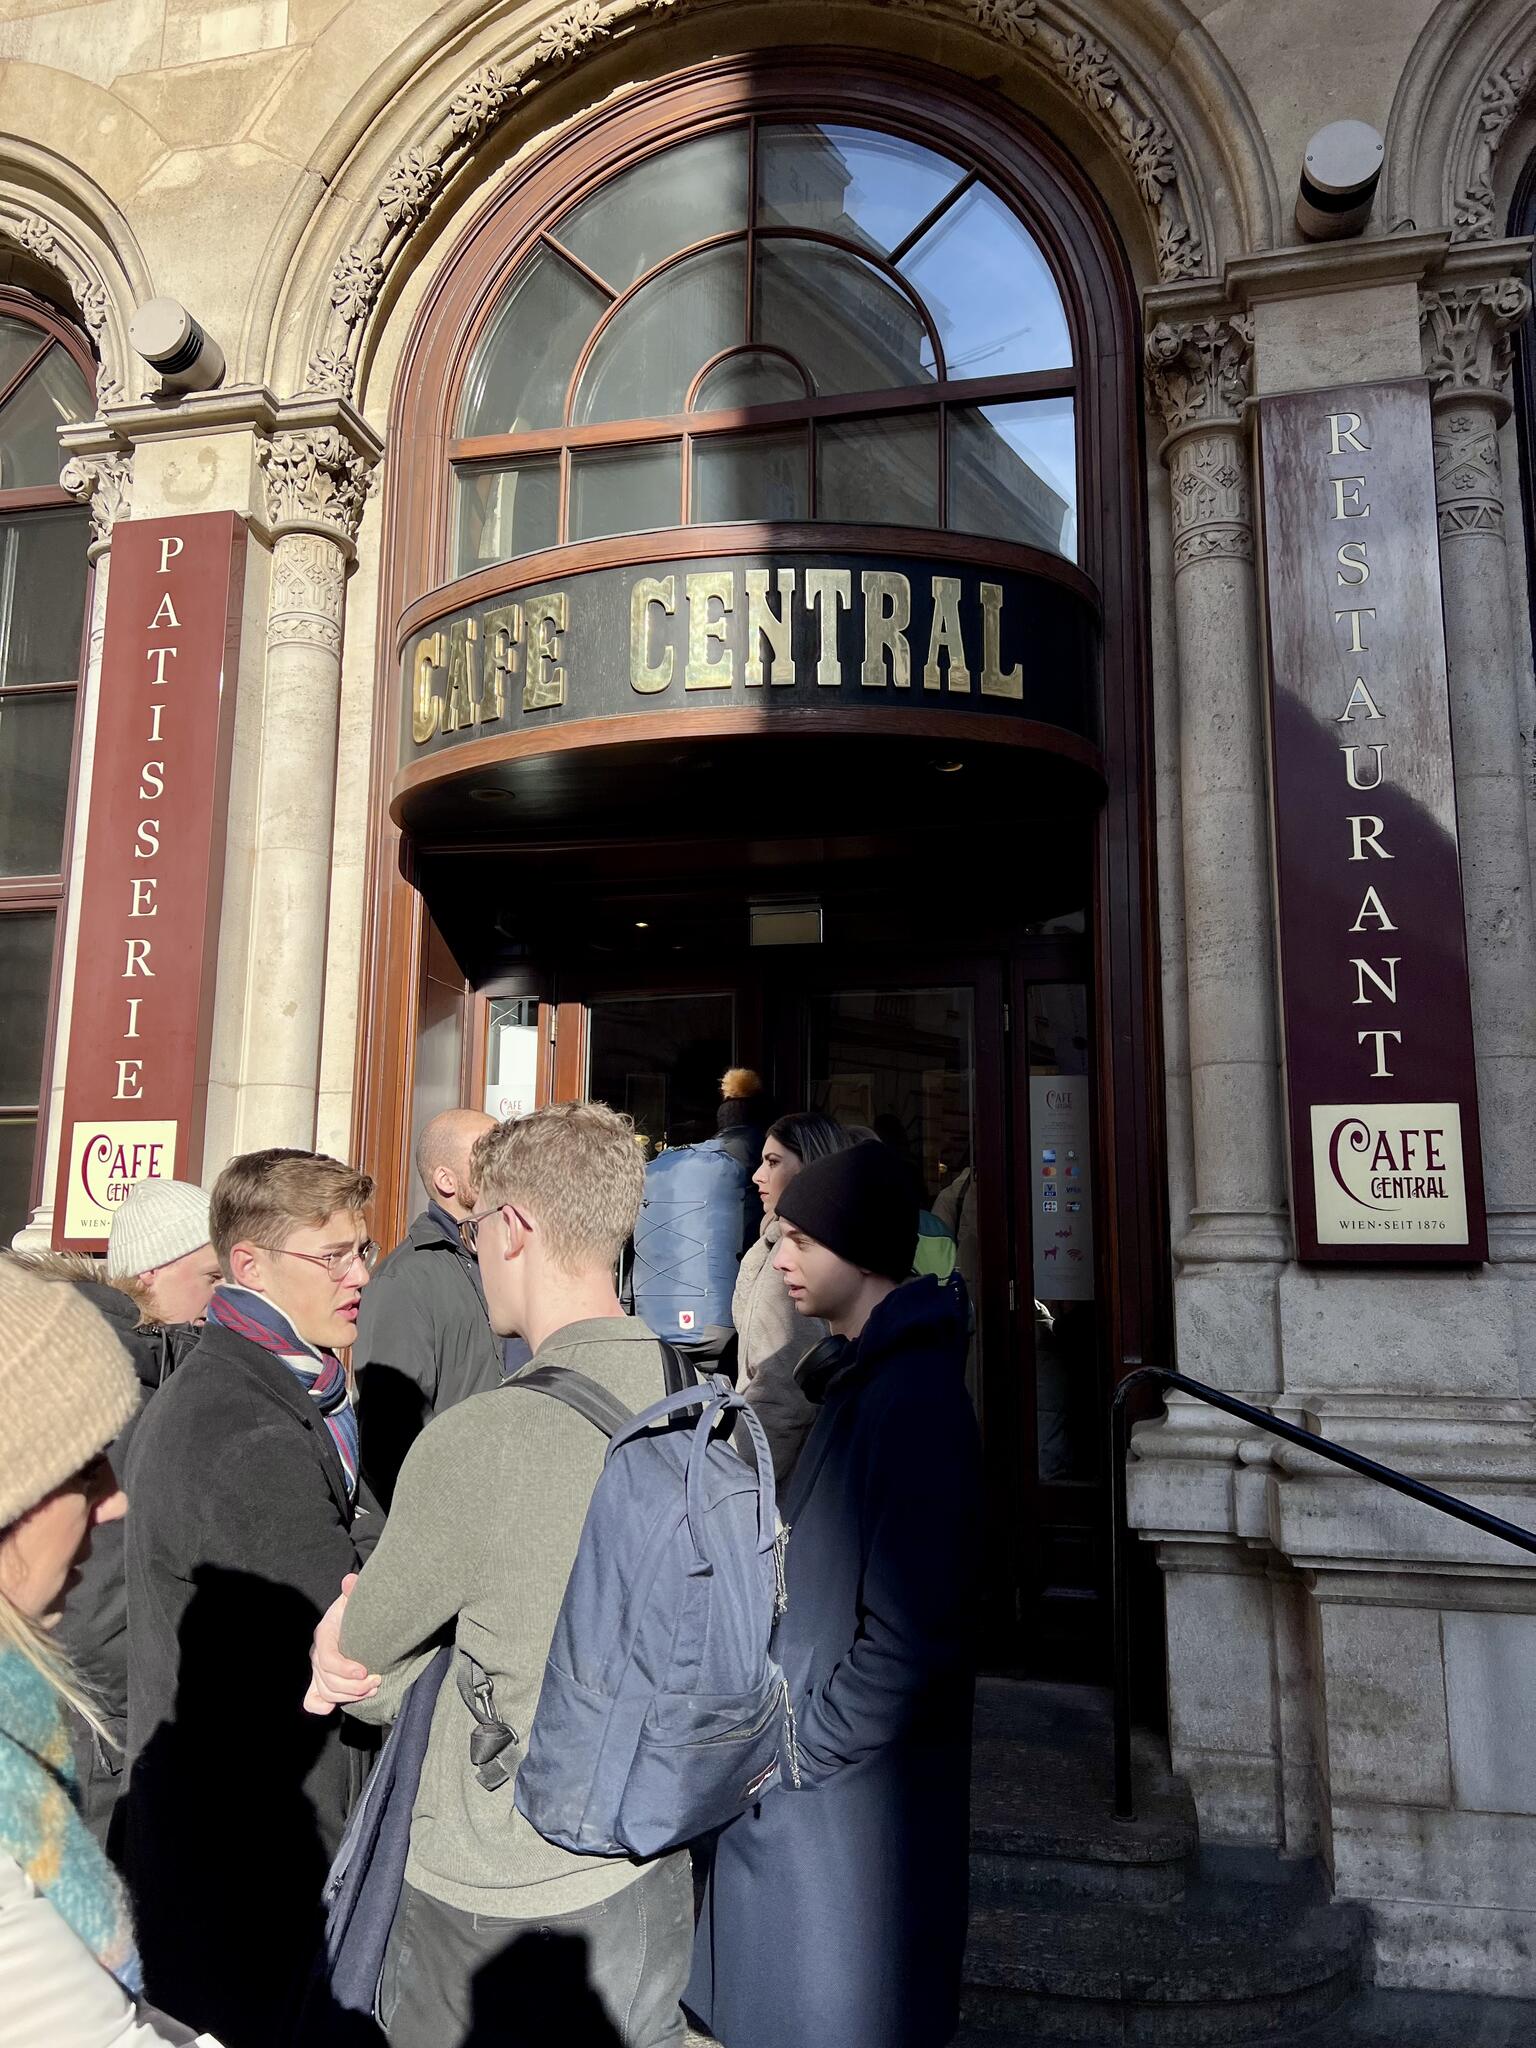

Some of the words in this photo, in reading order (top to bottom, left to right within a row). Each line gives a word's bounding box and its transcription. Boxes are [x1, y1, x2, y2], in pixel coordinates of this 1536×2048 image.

[412, 592, 567, 745] CAFE
[630, 568, 1024, 700] CENTRAL
[1325, 412, 1402, 1077] RESTAURANT
[112, 536, 184, 1100] PATISSERIE
[81, 1134, 164, 1212] CAFE
[1329, 1118, 1447, 1211] CAFE
[1371, 1177, 1449, 1199] CENTRAL
[1418, 1220, 1446, 1230] 1876
